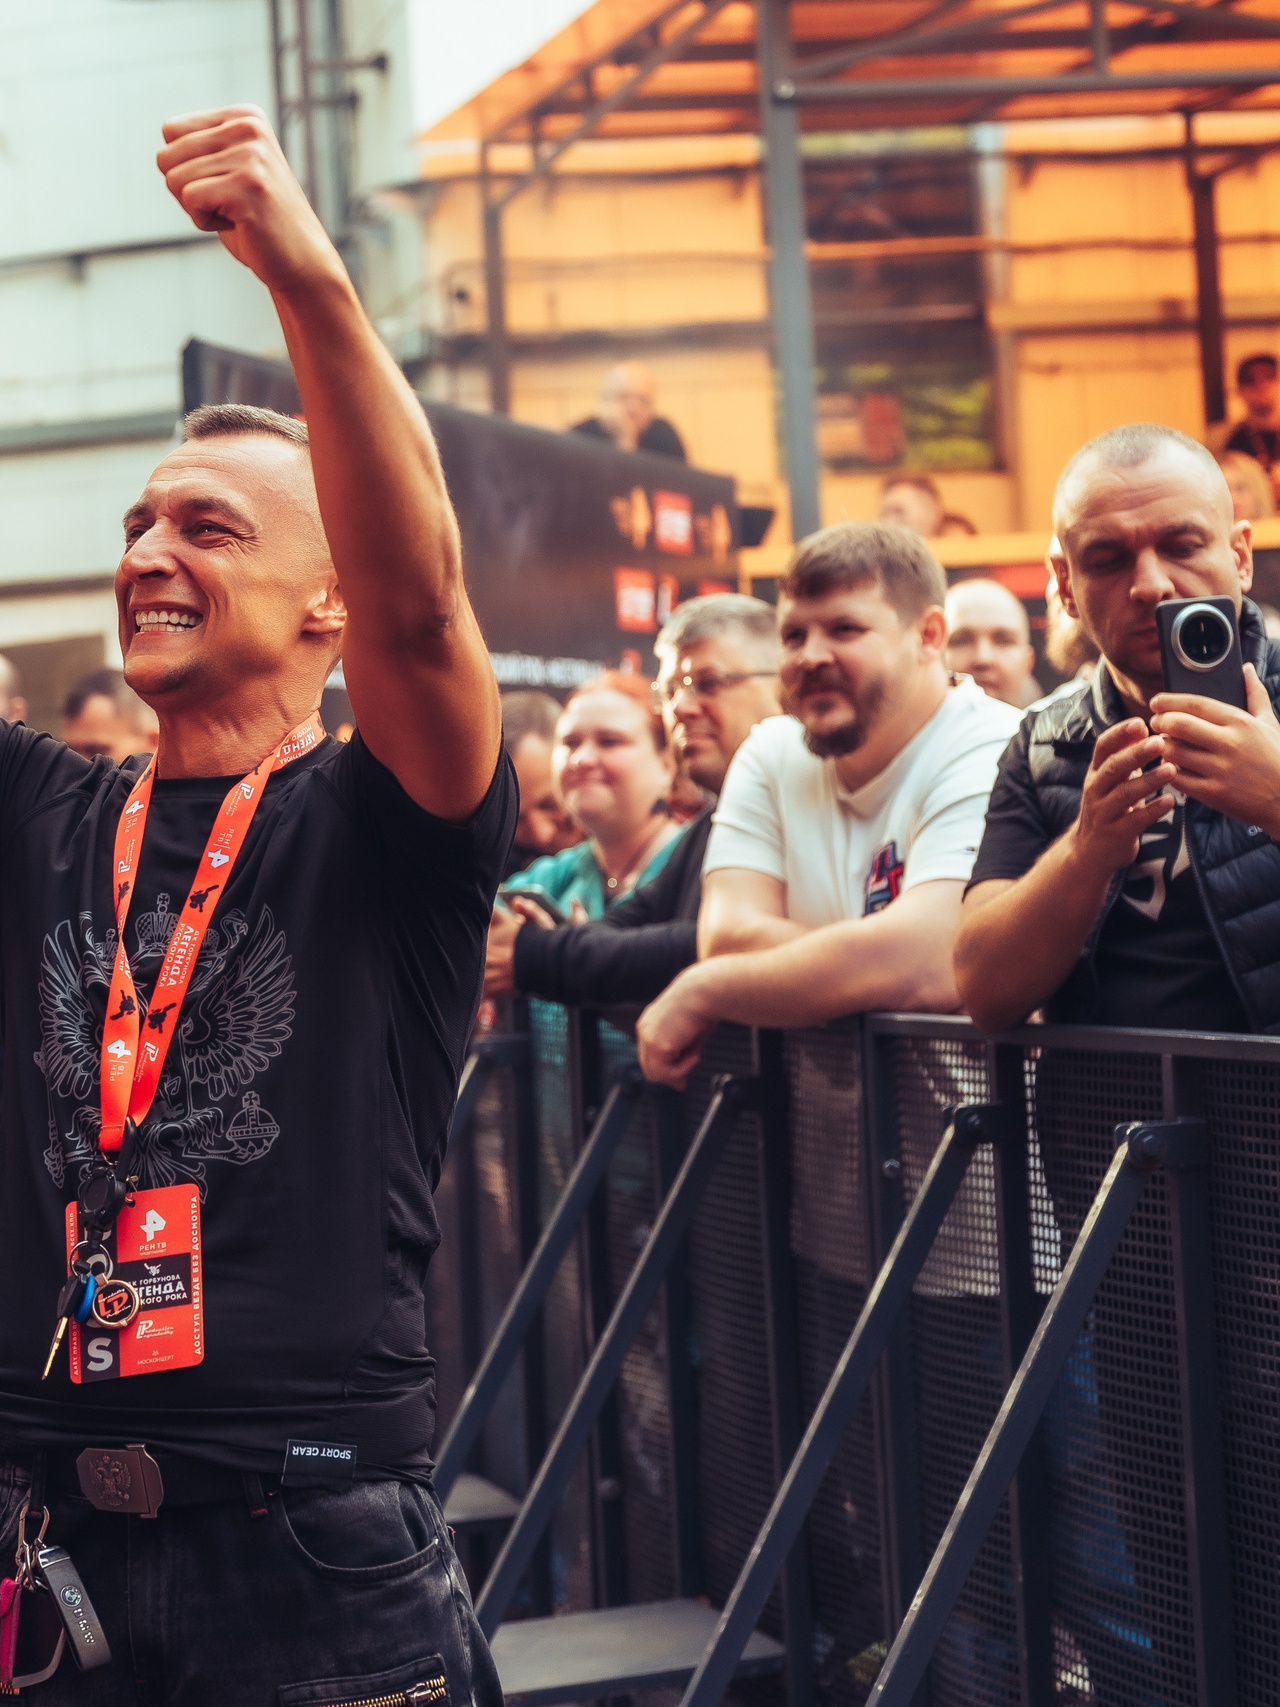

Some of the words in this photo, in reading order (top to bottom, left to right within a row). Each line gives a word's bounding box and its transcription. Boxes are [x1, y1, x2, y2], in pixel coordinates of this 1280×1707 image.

[218, 832, 226, 843] ТВ
[224, 828, 234, 845] РЕН
[193, 930, 199, 941] ДК
[166, 922, 186, 963] РУССКОГО
[166, 925, 194, 987] ЛЕГЕНДА
[178, 943, 195, 985] ГОРБУНОВА
[158, 965, 170, 988] РОКА
[117, 1065, 125, 1075] ТВ
[139, 1244, 155, 1252] РЕН
[140, 1274, 181, 1286] ГОРБУНОВА
[140, 1297, 162, 1305] КОГО
[165, 1292, 188, 1302] РОКА
[136, 1354, 175, 1365] МОСКОНЦЕРТ
[292, 1446, 319, 1457] GEAR
[320, 1447, 352, 1460] SPORT
